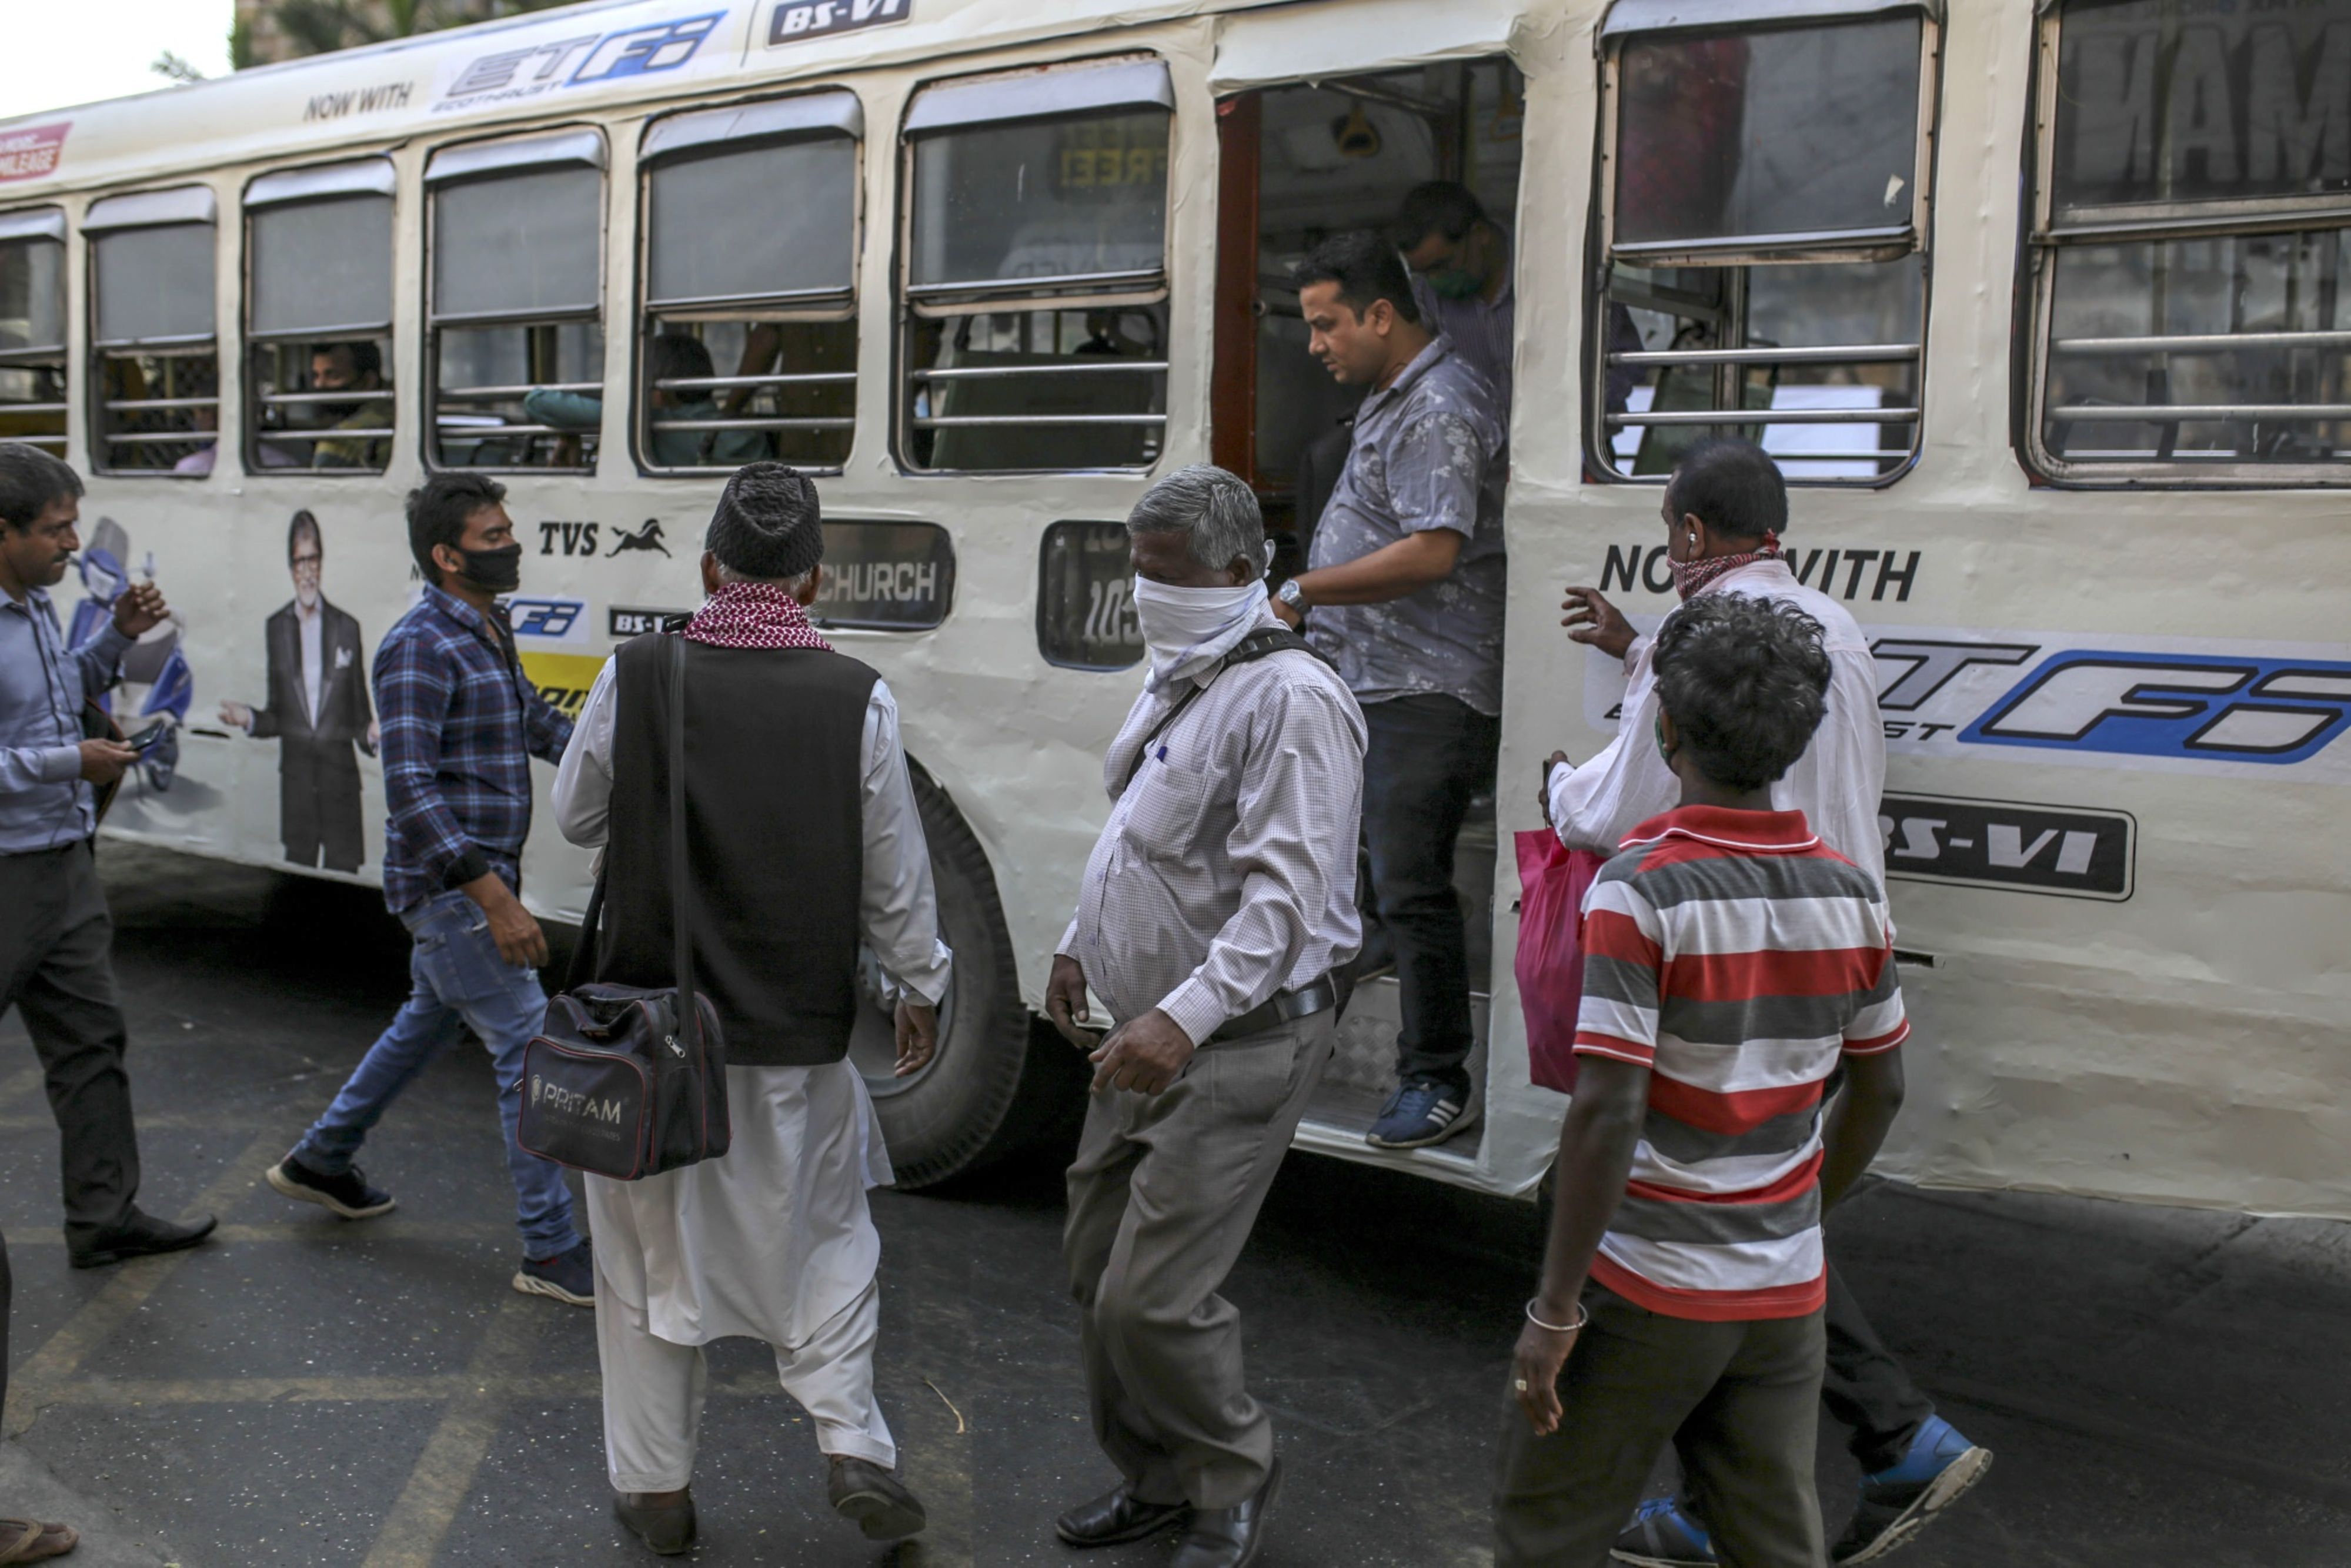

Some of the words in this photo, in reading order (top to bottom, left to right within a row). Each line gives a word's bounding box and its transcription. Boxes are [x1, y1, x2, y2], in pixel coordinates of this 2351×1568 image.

[303, 89, 358, 122] NOW
[358, 79, 414, 113] WITH
[539, 520, 599, 556] TVS
[816, 562, 937, 602] CHURCH
[1599, 544, 1675, 593] NO
[543, 1082, 622, 1125] PRITAM
